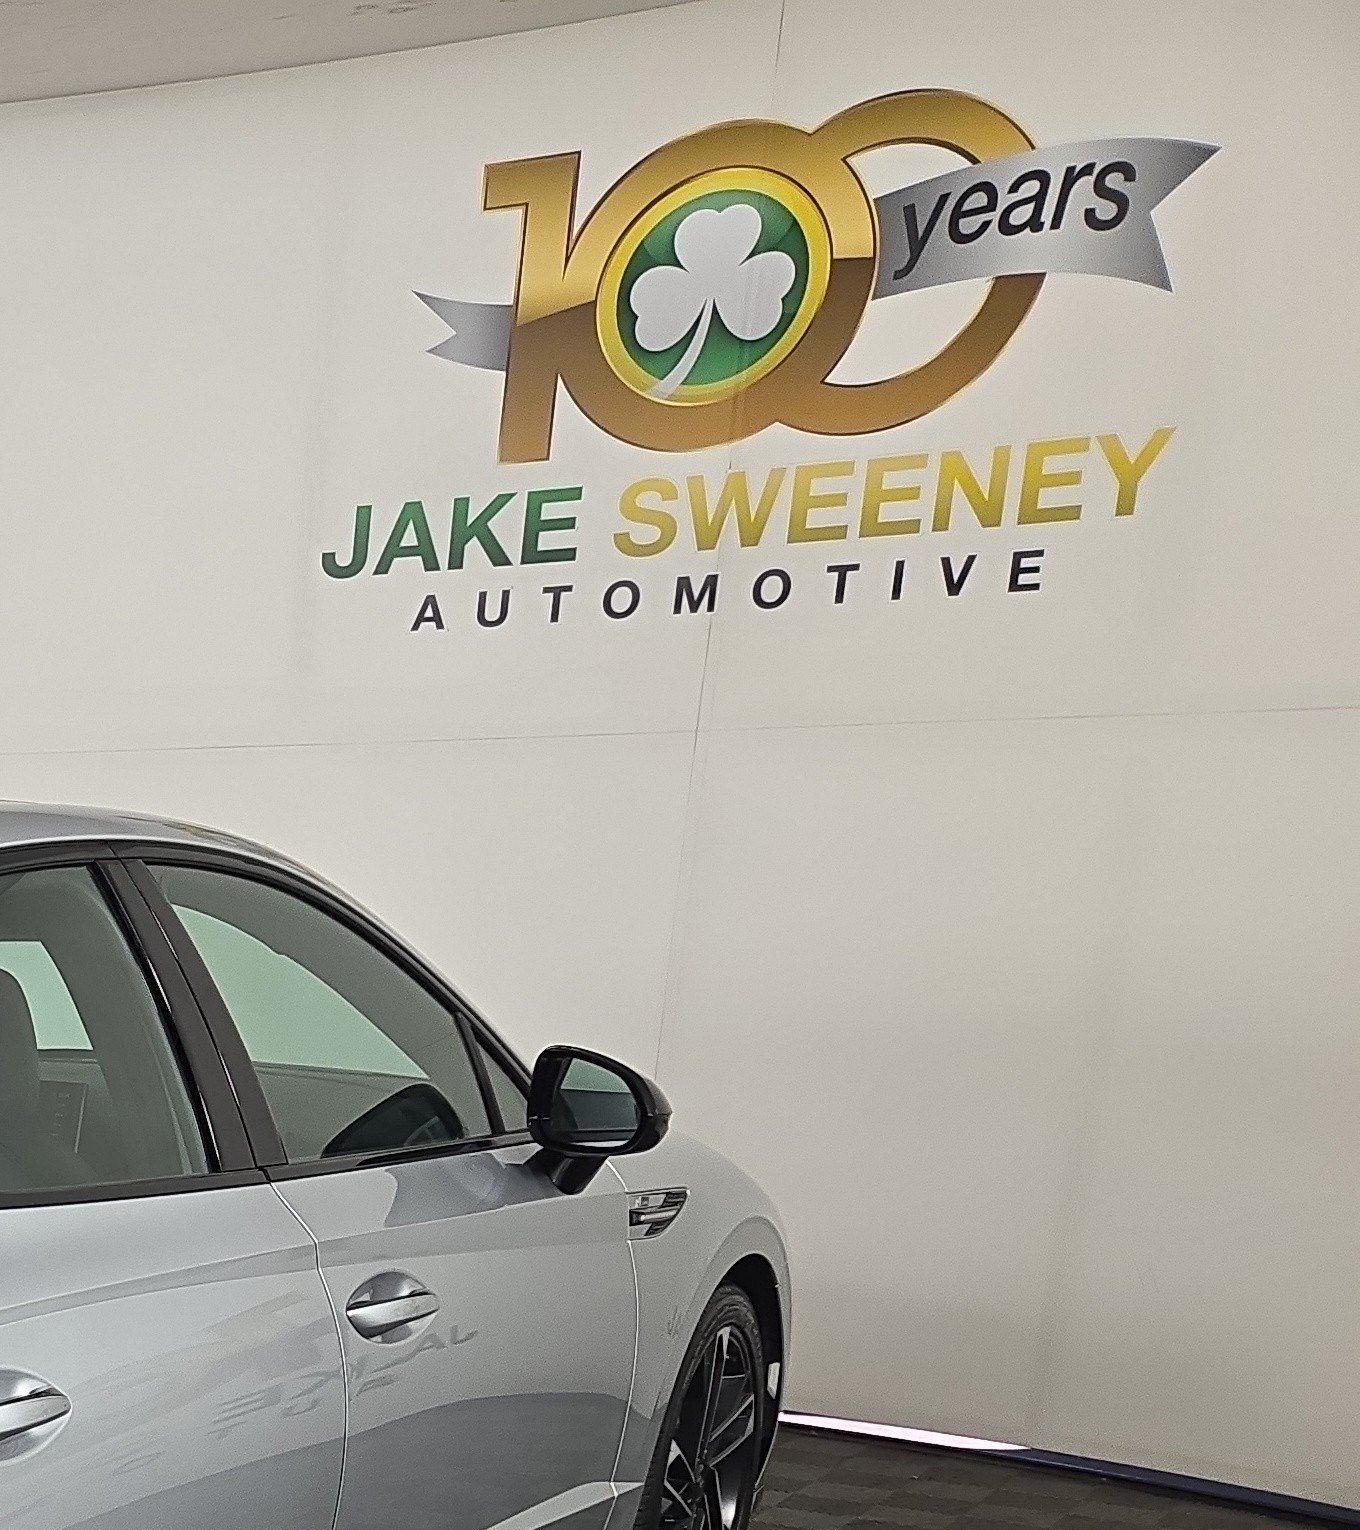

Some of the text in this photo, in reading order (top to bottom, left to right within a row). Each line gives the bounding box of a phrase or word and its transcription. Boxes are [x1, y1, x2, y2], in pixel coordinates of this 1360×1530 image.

[483, 89, 1138, 464] 100 years
[321, 426, 1177, 579] JAKE SWEENEY
[410, 549, 1046, 632] AUTOMOTIVE
